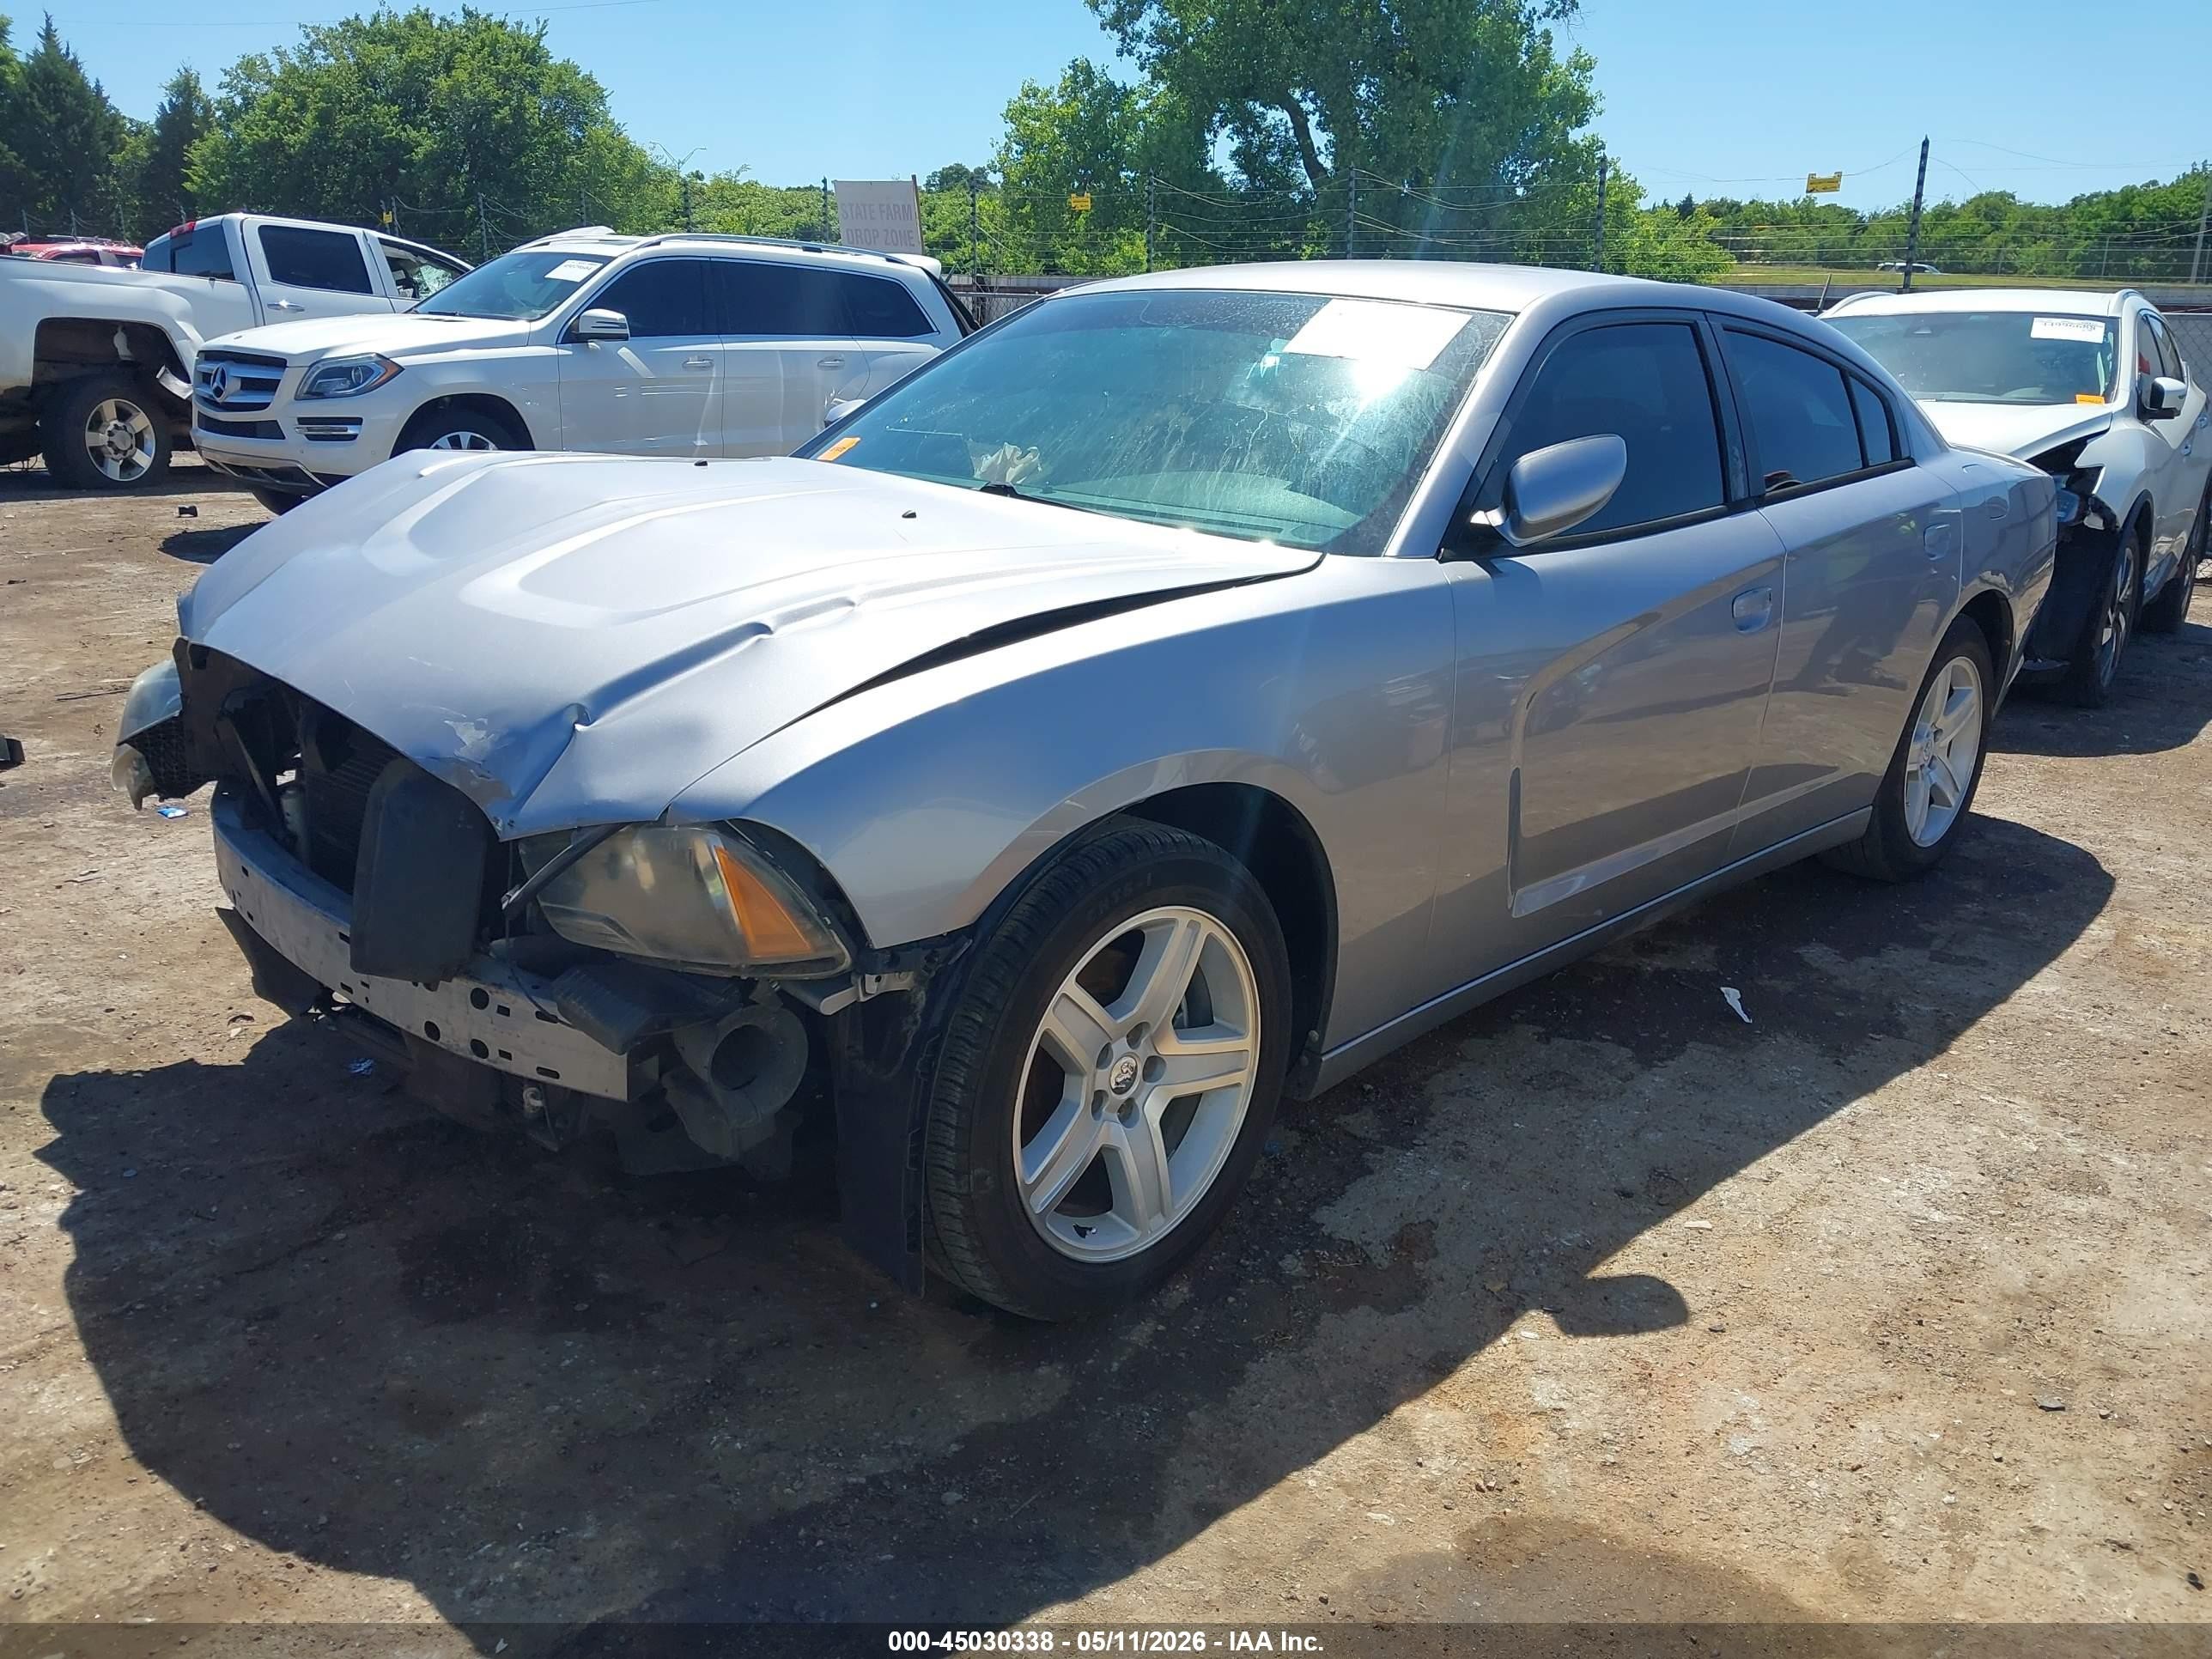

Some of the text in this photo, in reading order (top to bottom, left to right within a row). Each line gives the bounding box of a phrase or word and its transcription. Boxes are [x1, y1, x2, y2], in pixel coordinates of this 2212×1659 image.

[841, 203, 913, 221] STATE FARM
[845, 228, 915, 247] DROP ZONE
